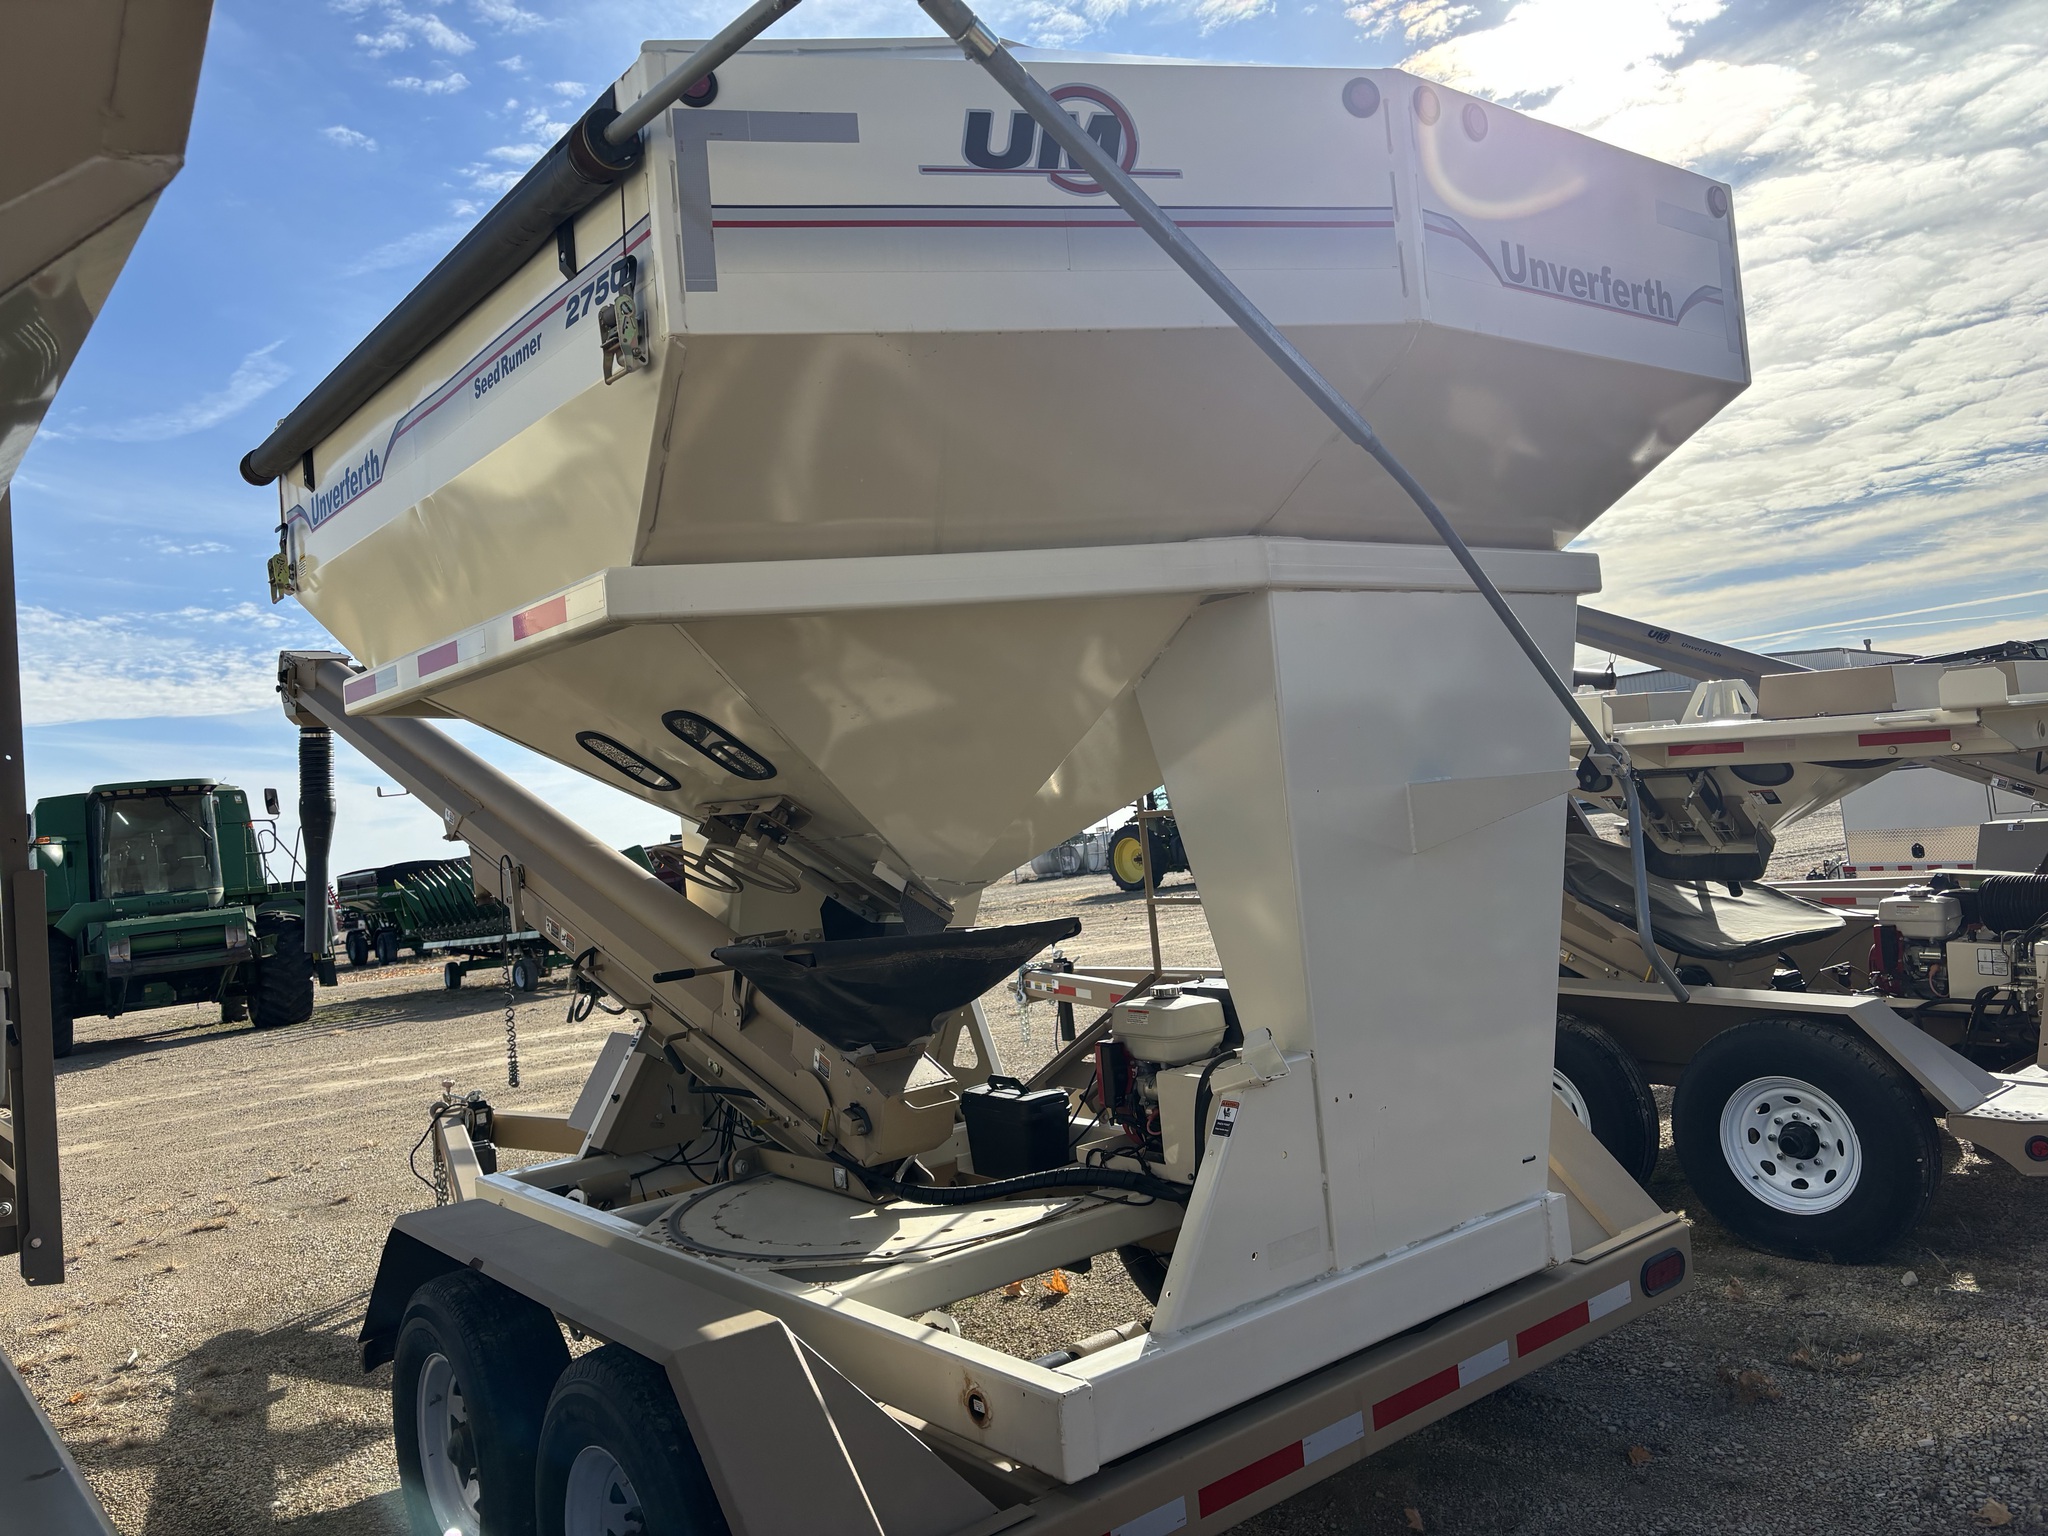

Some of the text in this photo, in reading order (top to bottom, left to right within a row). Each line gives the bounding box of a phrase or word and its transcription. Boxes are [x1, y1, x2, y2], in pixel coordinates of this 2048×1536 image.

[565, 257, 627, 329] 2750
[1501, 240, 1675, 319] Unverferth
[311, 449, 380, 526] Unverferth
[1648, 629, 1722, 657] UM Unverferth
